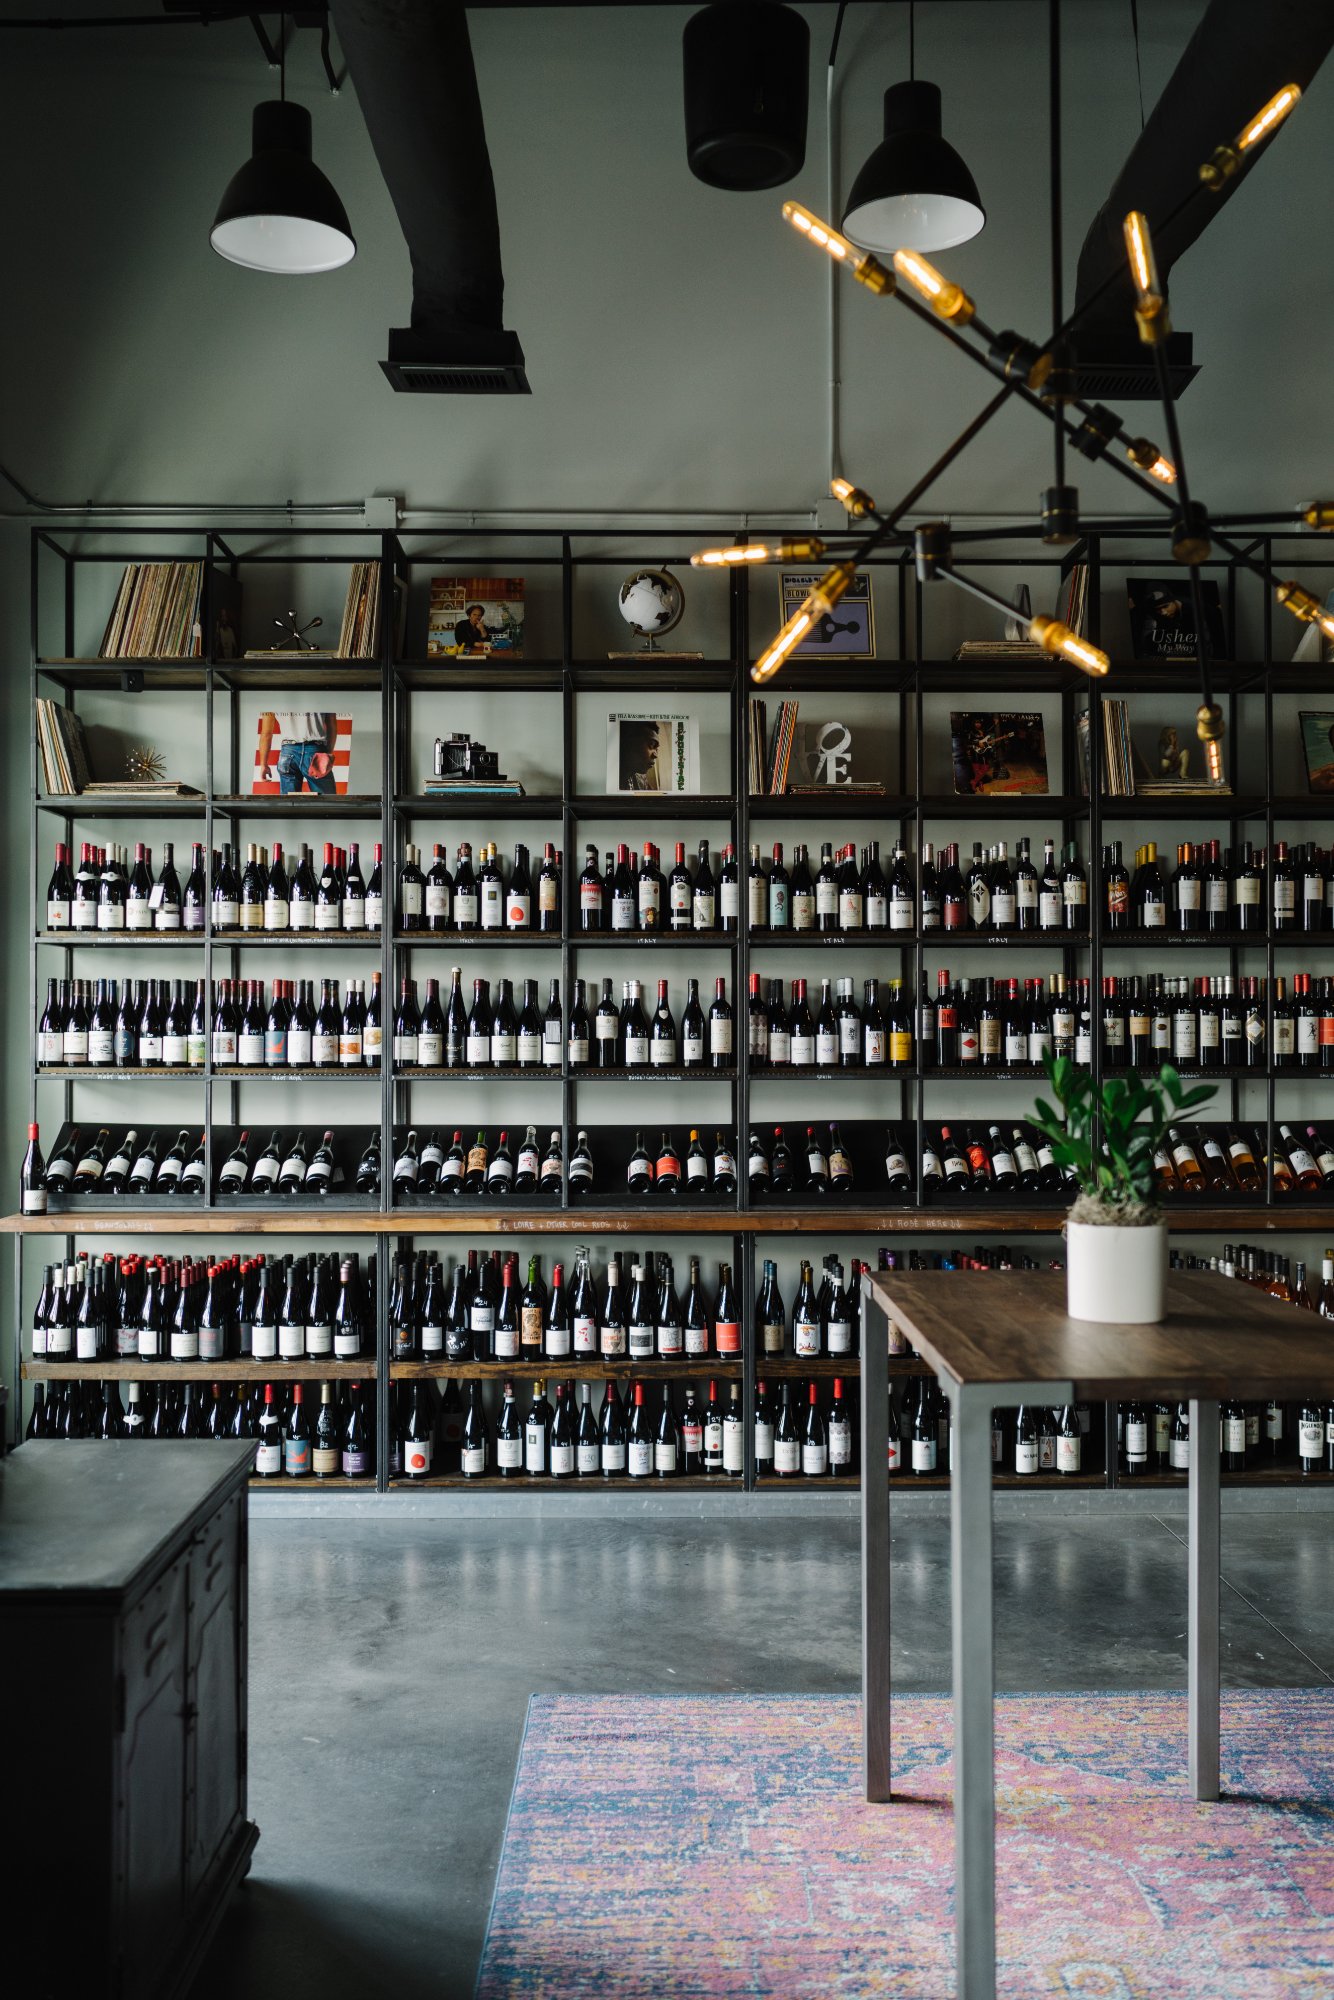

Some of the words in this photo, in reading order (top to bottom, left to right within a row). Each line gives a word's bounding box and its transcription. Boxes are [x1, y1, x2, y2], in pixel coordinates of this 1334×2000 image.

[513, 1221, 534, 1229] LOIRE
[546, 1221, 568, 1229] OTHER
[571, 1221, 588, 1229] COOL
[926, 1219, 947, 1227] HERE
